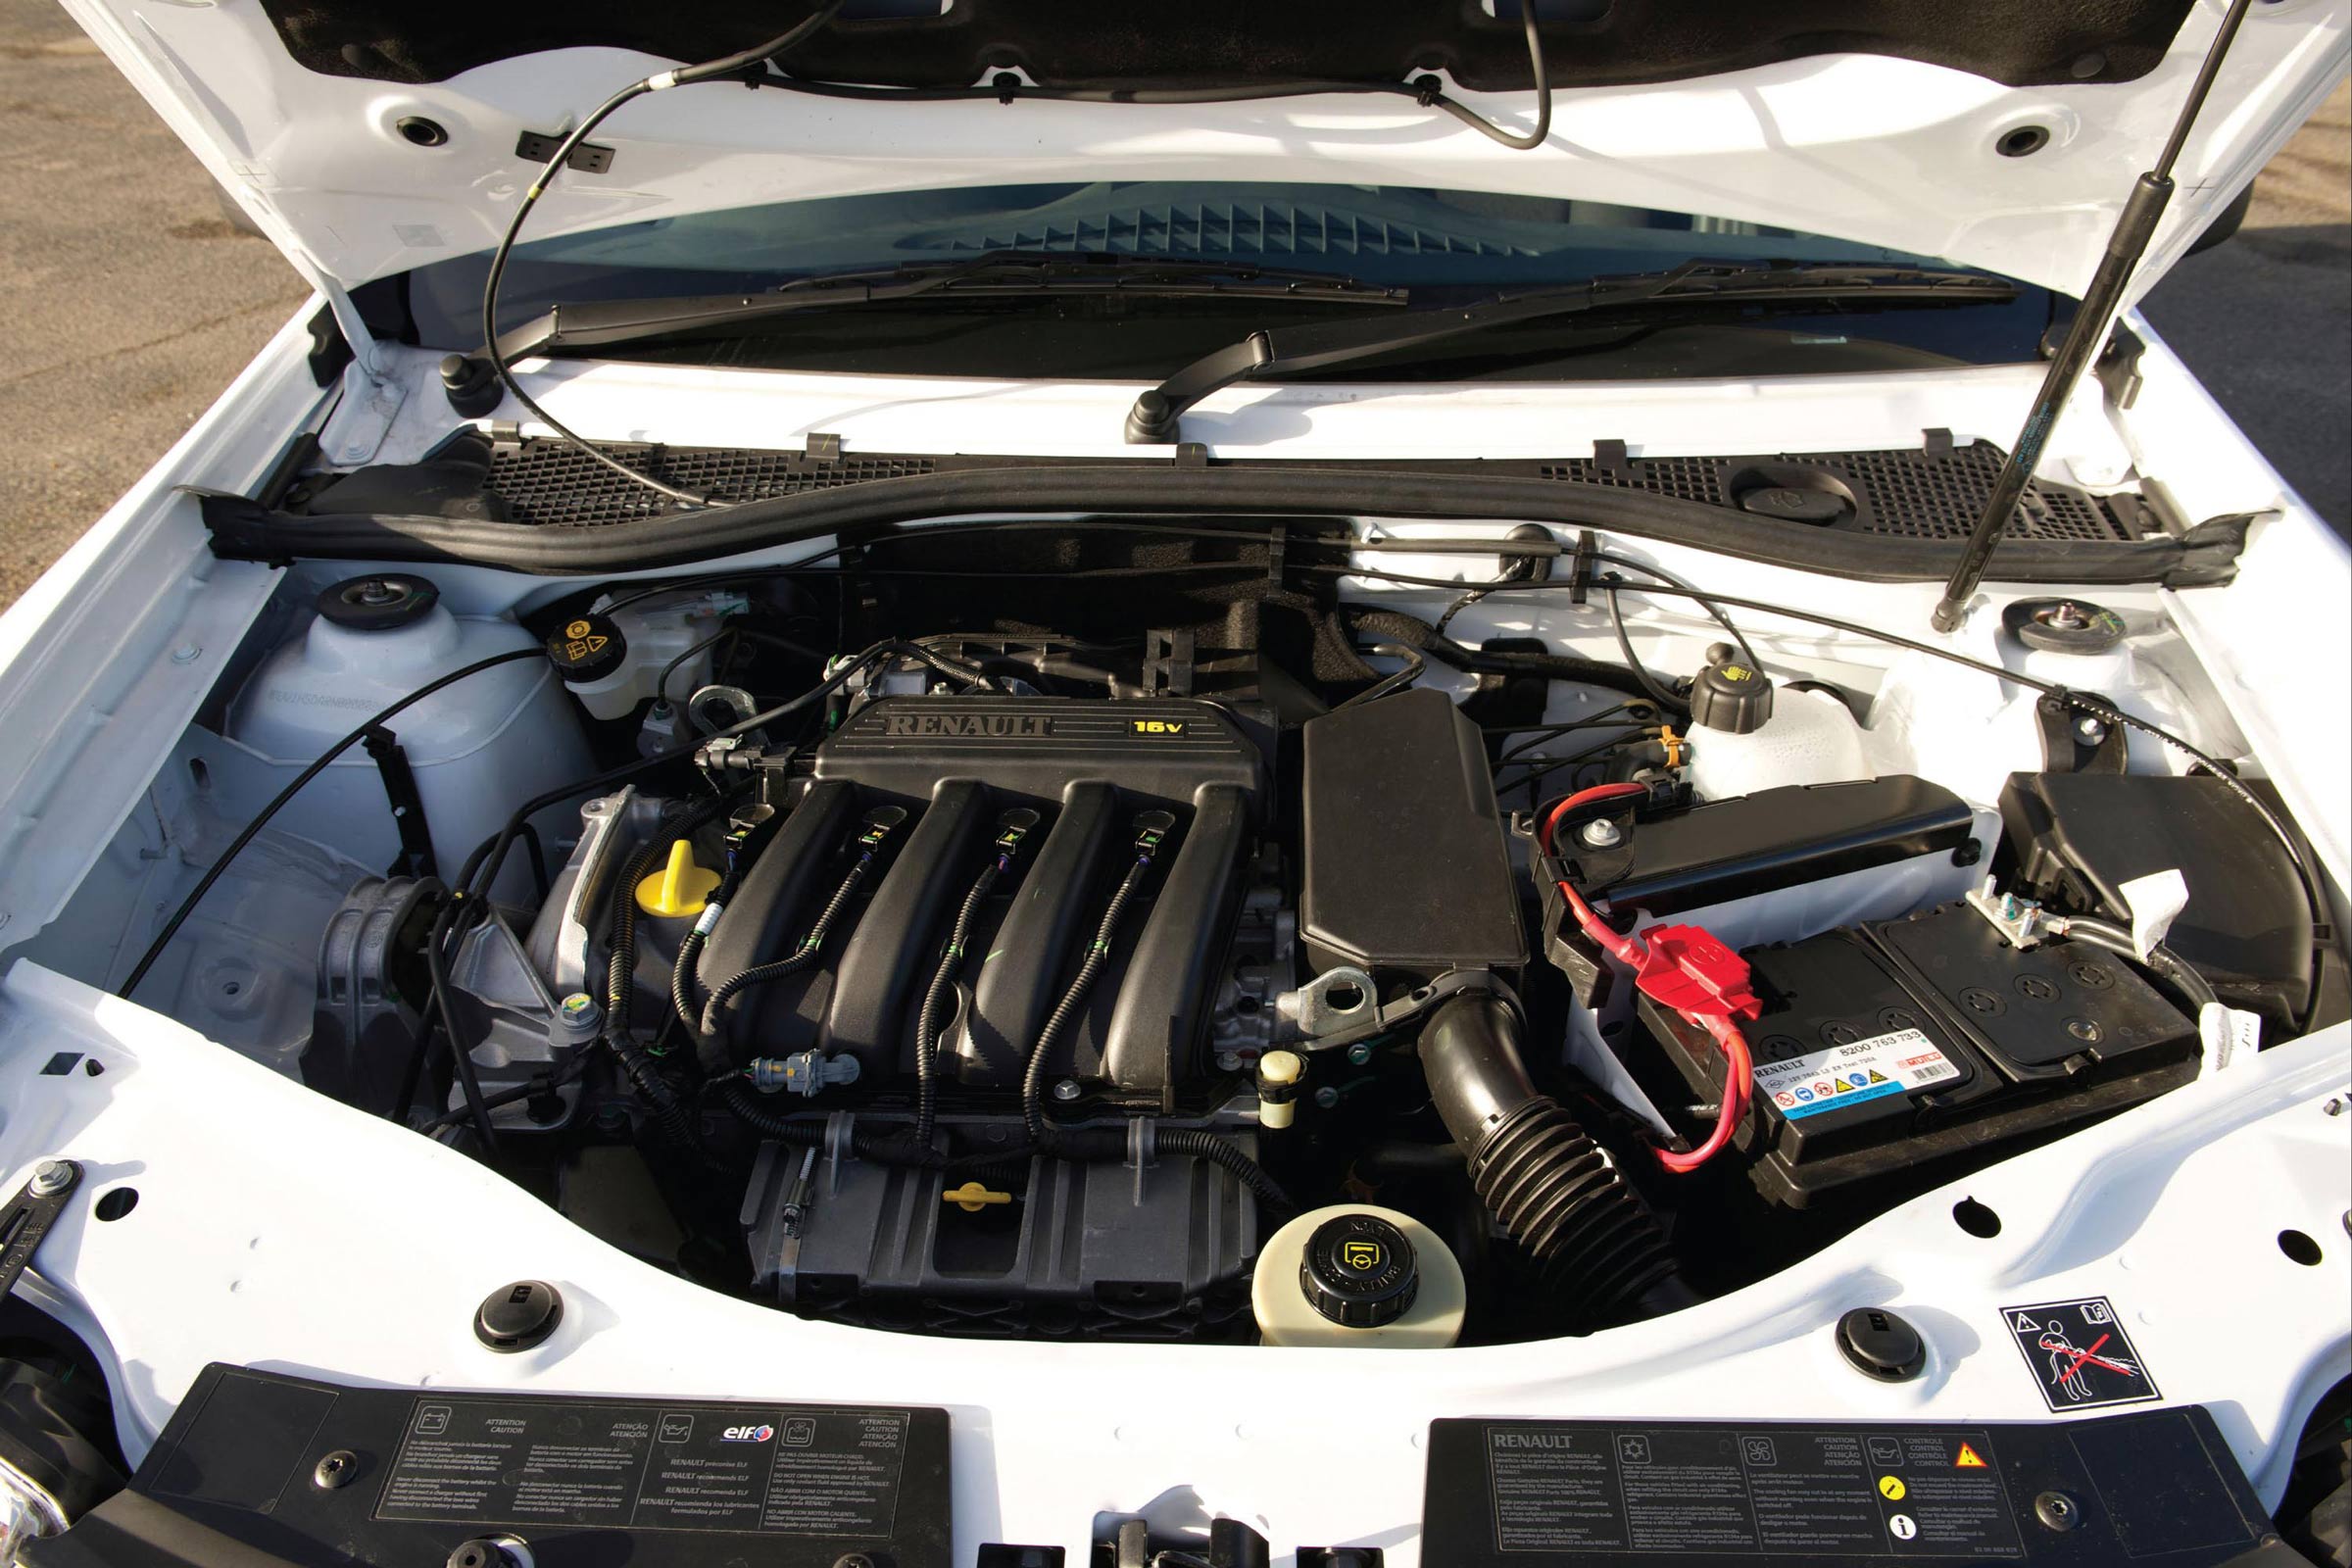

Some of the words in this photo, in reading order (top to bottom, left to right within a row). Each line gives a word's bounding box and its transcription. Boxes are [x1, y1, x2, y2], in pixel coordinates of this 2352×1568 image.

[887, 715, 1051, 736] RENAULT
[1134, 720, 1182, 734] 16v
[1839, 1043, 1872, 1056] 8200
[1873, 1036, 1896, 1048] 763
[1896, 1030, 1922, 1042] 733
[1754, 1059, 1805, 1078] RENAULT
[723, 1425, 754, 1440] elf
[1494, 1434, 1573, 1448] RENAULT
[661, 1471, 697, 1480] RENAULT
[665, 1486, 701, 1494] RENAULT
